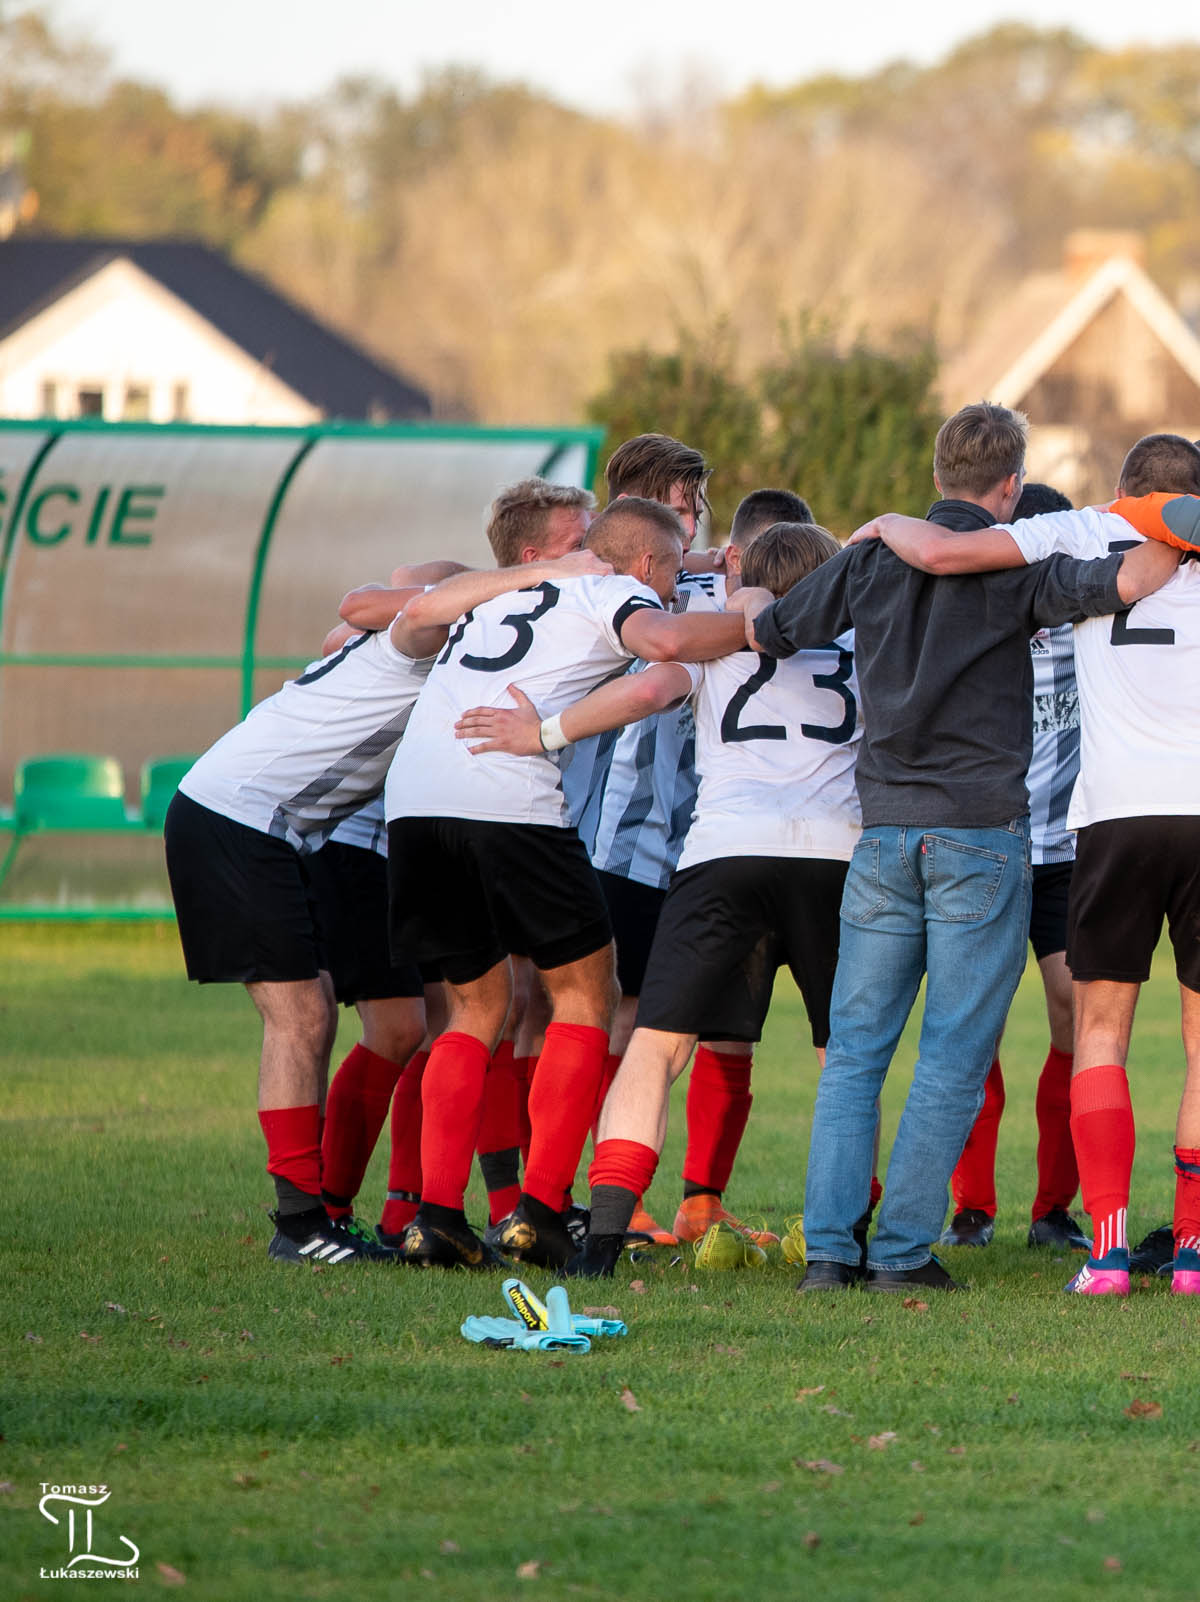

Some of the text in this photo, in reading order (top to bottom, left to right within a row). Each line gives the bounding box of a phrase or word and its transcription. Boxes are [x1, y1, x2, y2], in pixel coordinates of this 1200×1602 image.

[0, 468, 165, 546] CIE
[721, 640, 857, 744] 23
[509, 1288, 538, 1328] uhlsport
